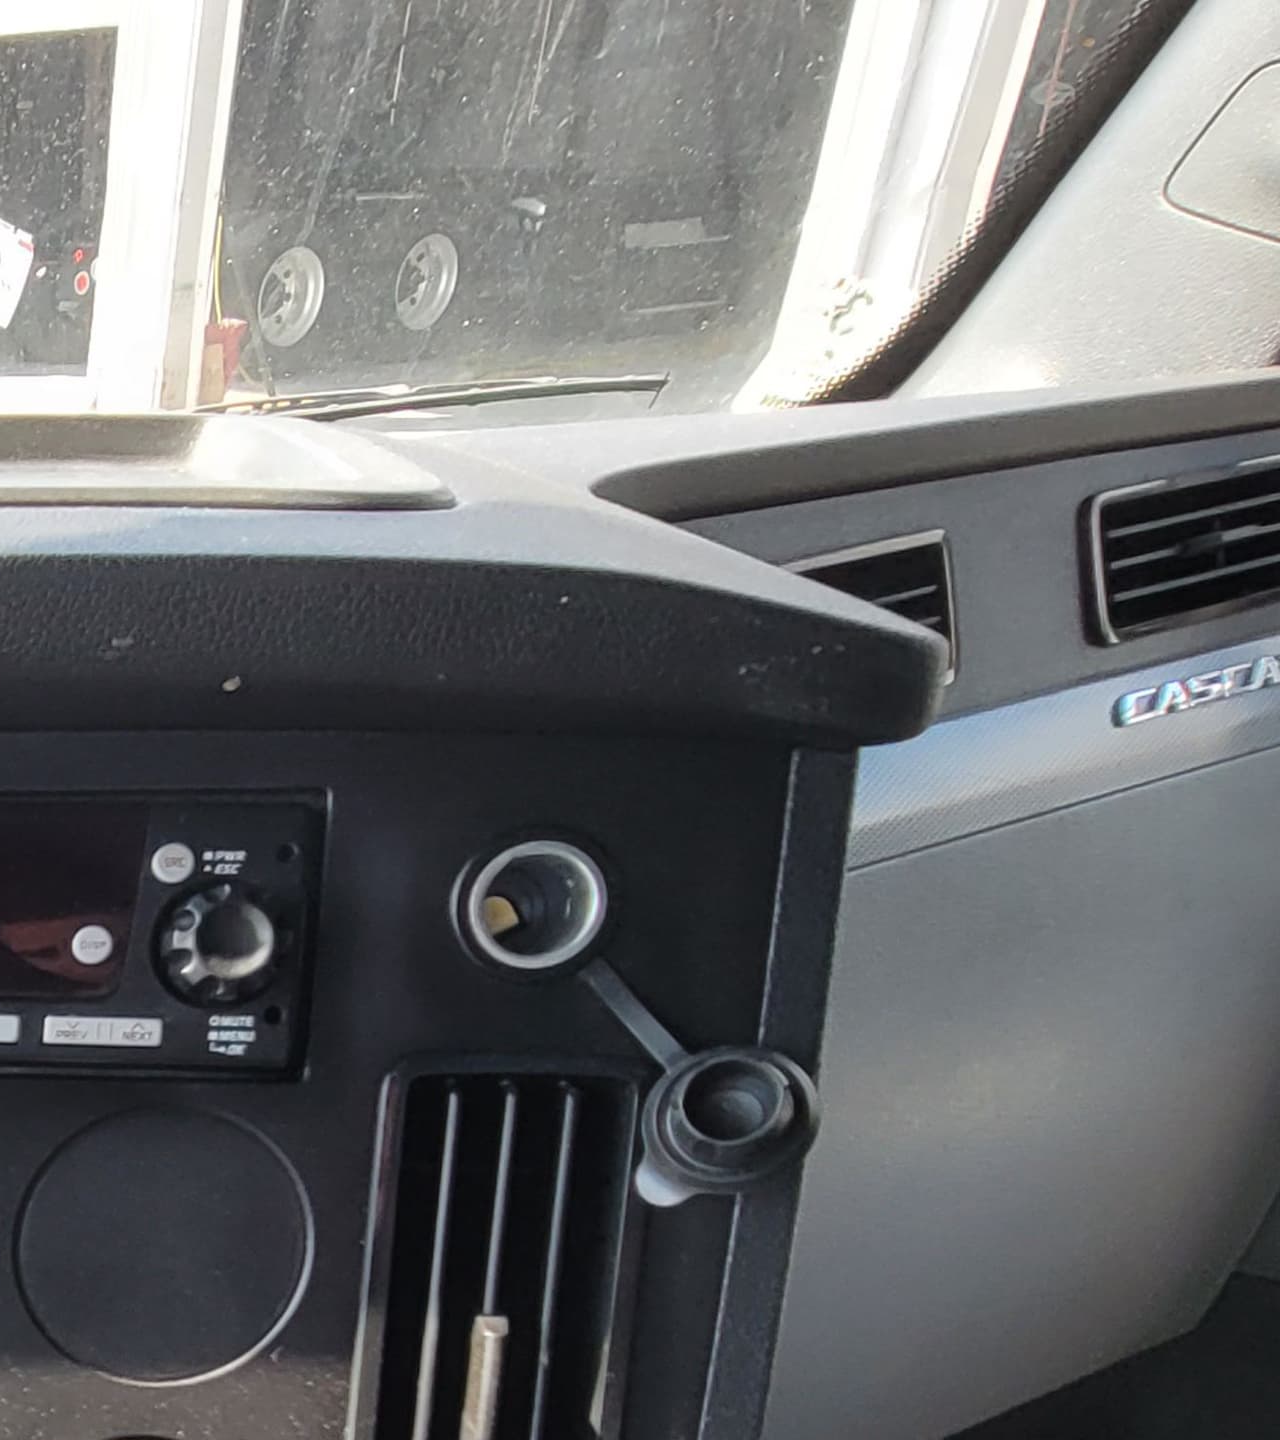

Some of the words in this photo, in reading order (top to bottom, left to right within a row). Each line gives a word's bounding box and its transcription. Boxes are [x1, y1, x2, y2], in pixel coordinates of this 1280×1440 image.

[213, 863, 242, 875] ESC
[55, 1029, 88, 1040] PREV
[121, 1031, 153, 1041] NEXT
